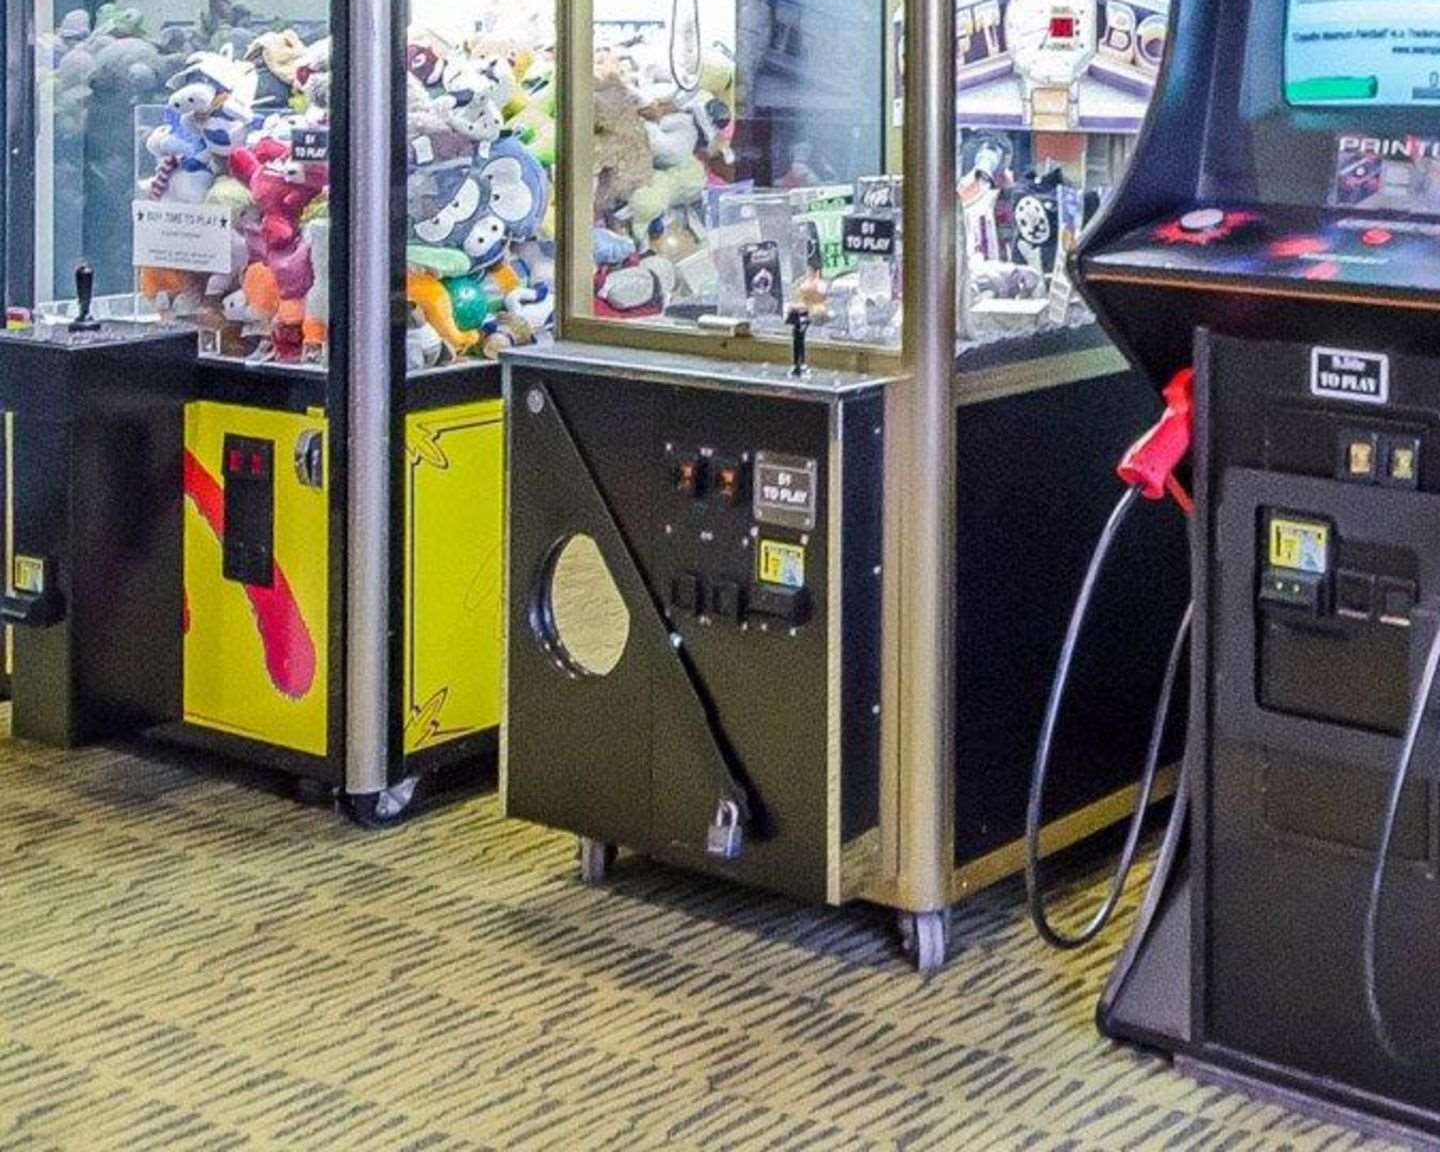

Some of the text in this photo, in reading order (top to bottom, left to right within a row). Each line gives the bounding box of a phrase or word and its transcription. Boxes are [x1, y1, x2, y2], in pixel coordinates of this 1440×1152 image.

[847, 235, 891, 251] TO PLAY
[1320, 371, 1377, 394] TO PLAY
[762, 485, 807, 503] TO PLAY
